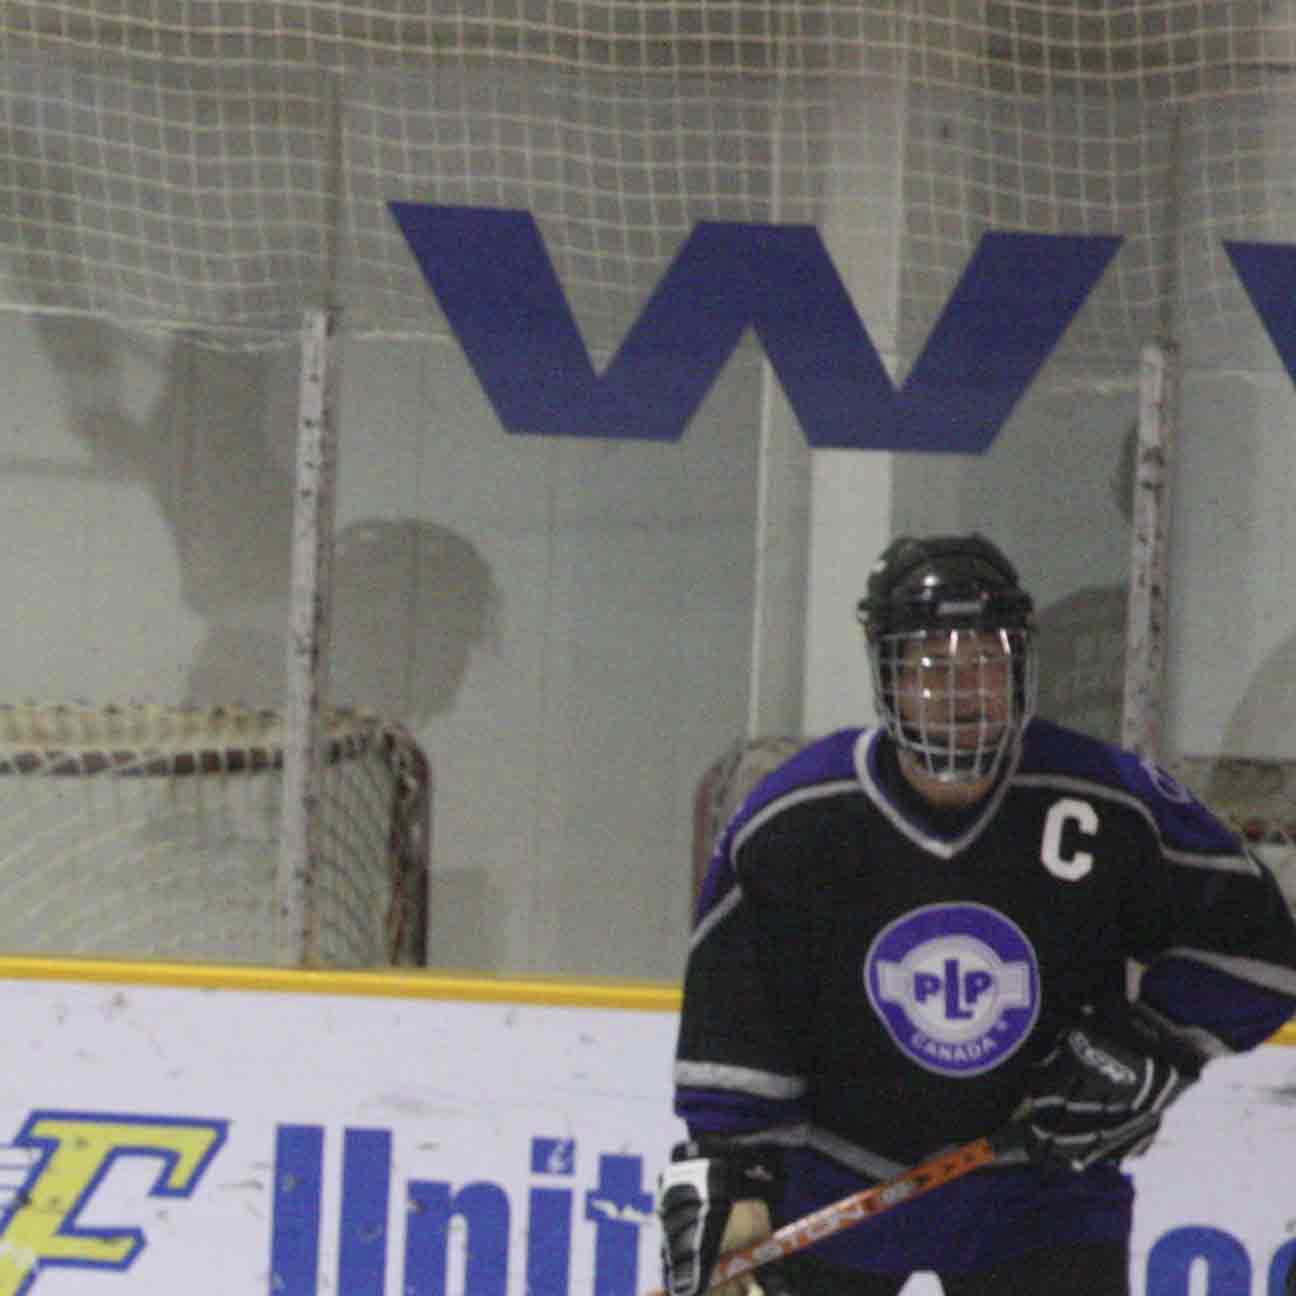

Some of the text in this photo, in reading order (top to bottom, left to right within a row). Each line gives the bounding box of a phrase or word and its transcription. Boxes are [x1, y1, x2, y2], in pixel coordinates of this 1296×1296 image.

[386, 199, 1296, 455] W
[1041, 800, 1099, 881] C
[913, 959, 993, 1020] PLP
[910, 1031, 998, 1062] CANADA
